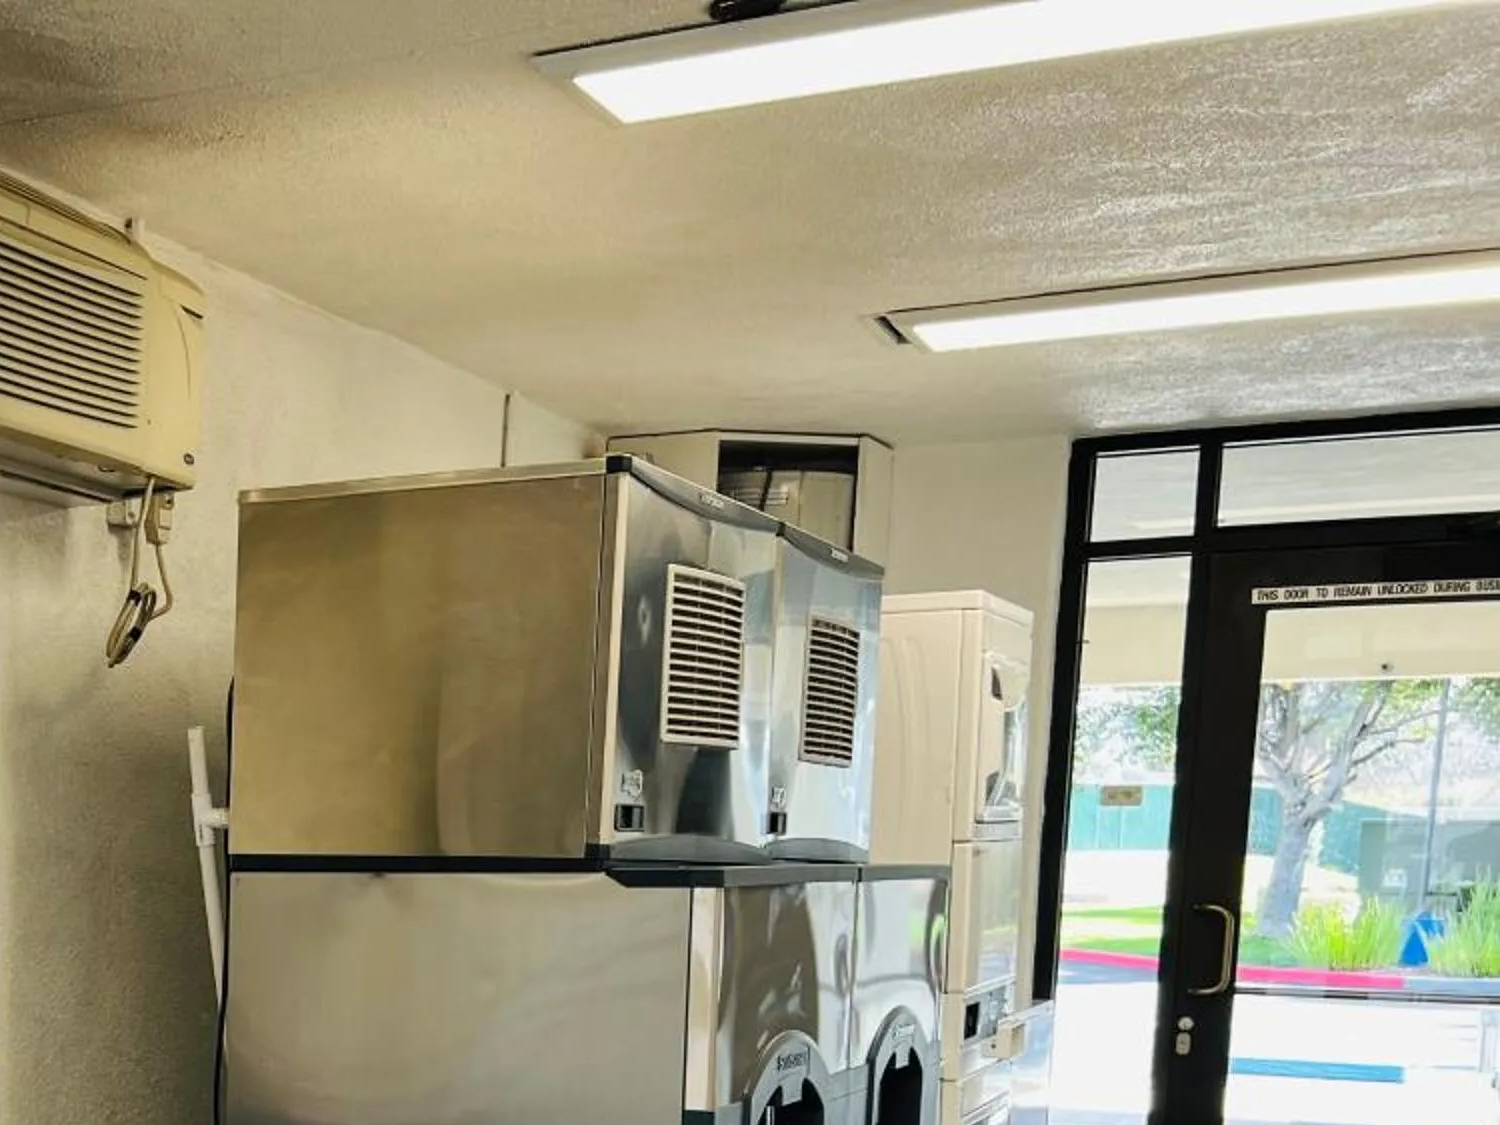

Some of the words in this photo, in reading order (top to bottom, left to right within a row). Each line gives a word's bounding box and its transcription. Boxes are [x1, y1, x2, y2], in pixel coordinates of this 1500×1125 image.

[1257, 589, 1279, 601] THIS
[1284, 588, 1309, 601] DOOR
[1316, 587, 1329, 599] TO
[1333, 585, 1372, 599] REMAIN
[1377, 583, 1428, 597] UNLOCKED
[1434, 581, 1471, 594] DURING
